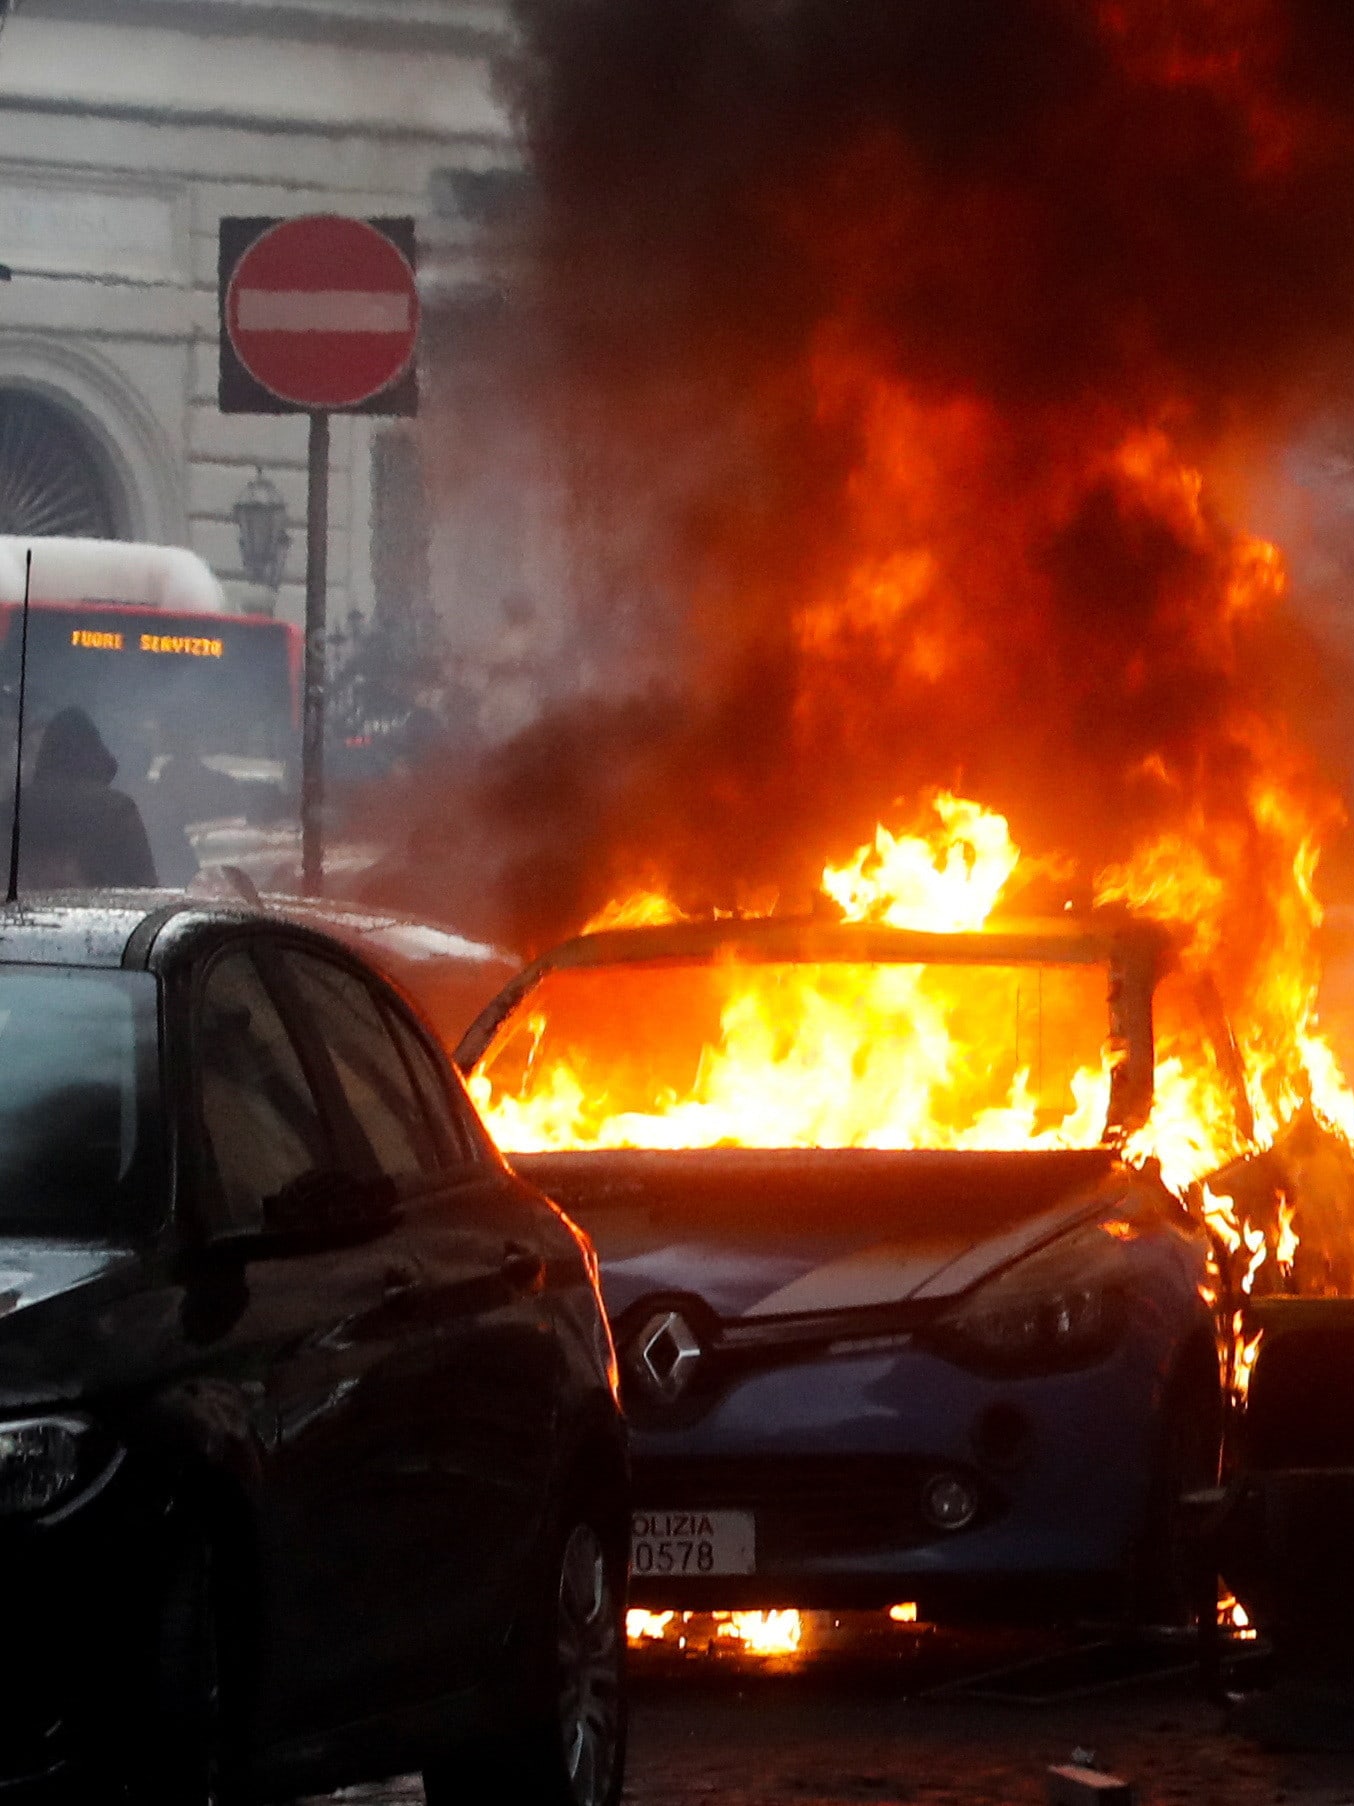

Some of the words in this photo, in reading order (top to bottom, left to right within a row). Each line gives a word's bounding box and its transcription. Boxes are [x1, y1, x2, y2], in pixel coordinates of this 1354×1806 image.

[70, 630, 125, 650] FUORI
[139, 634, 225, 657] SERVIZIO
[635, 1540, 714, 1572] 0578
